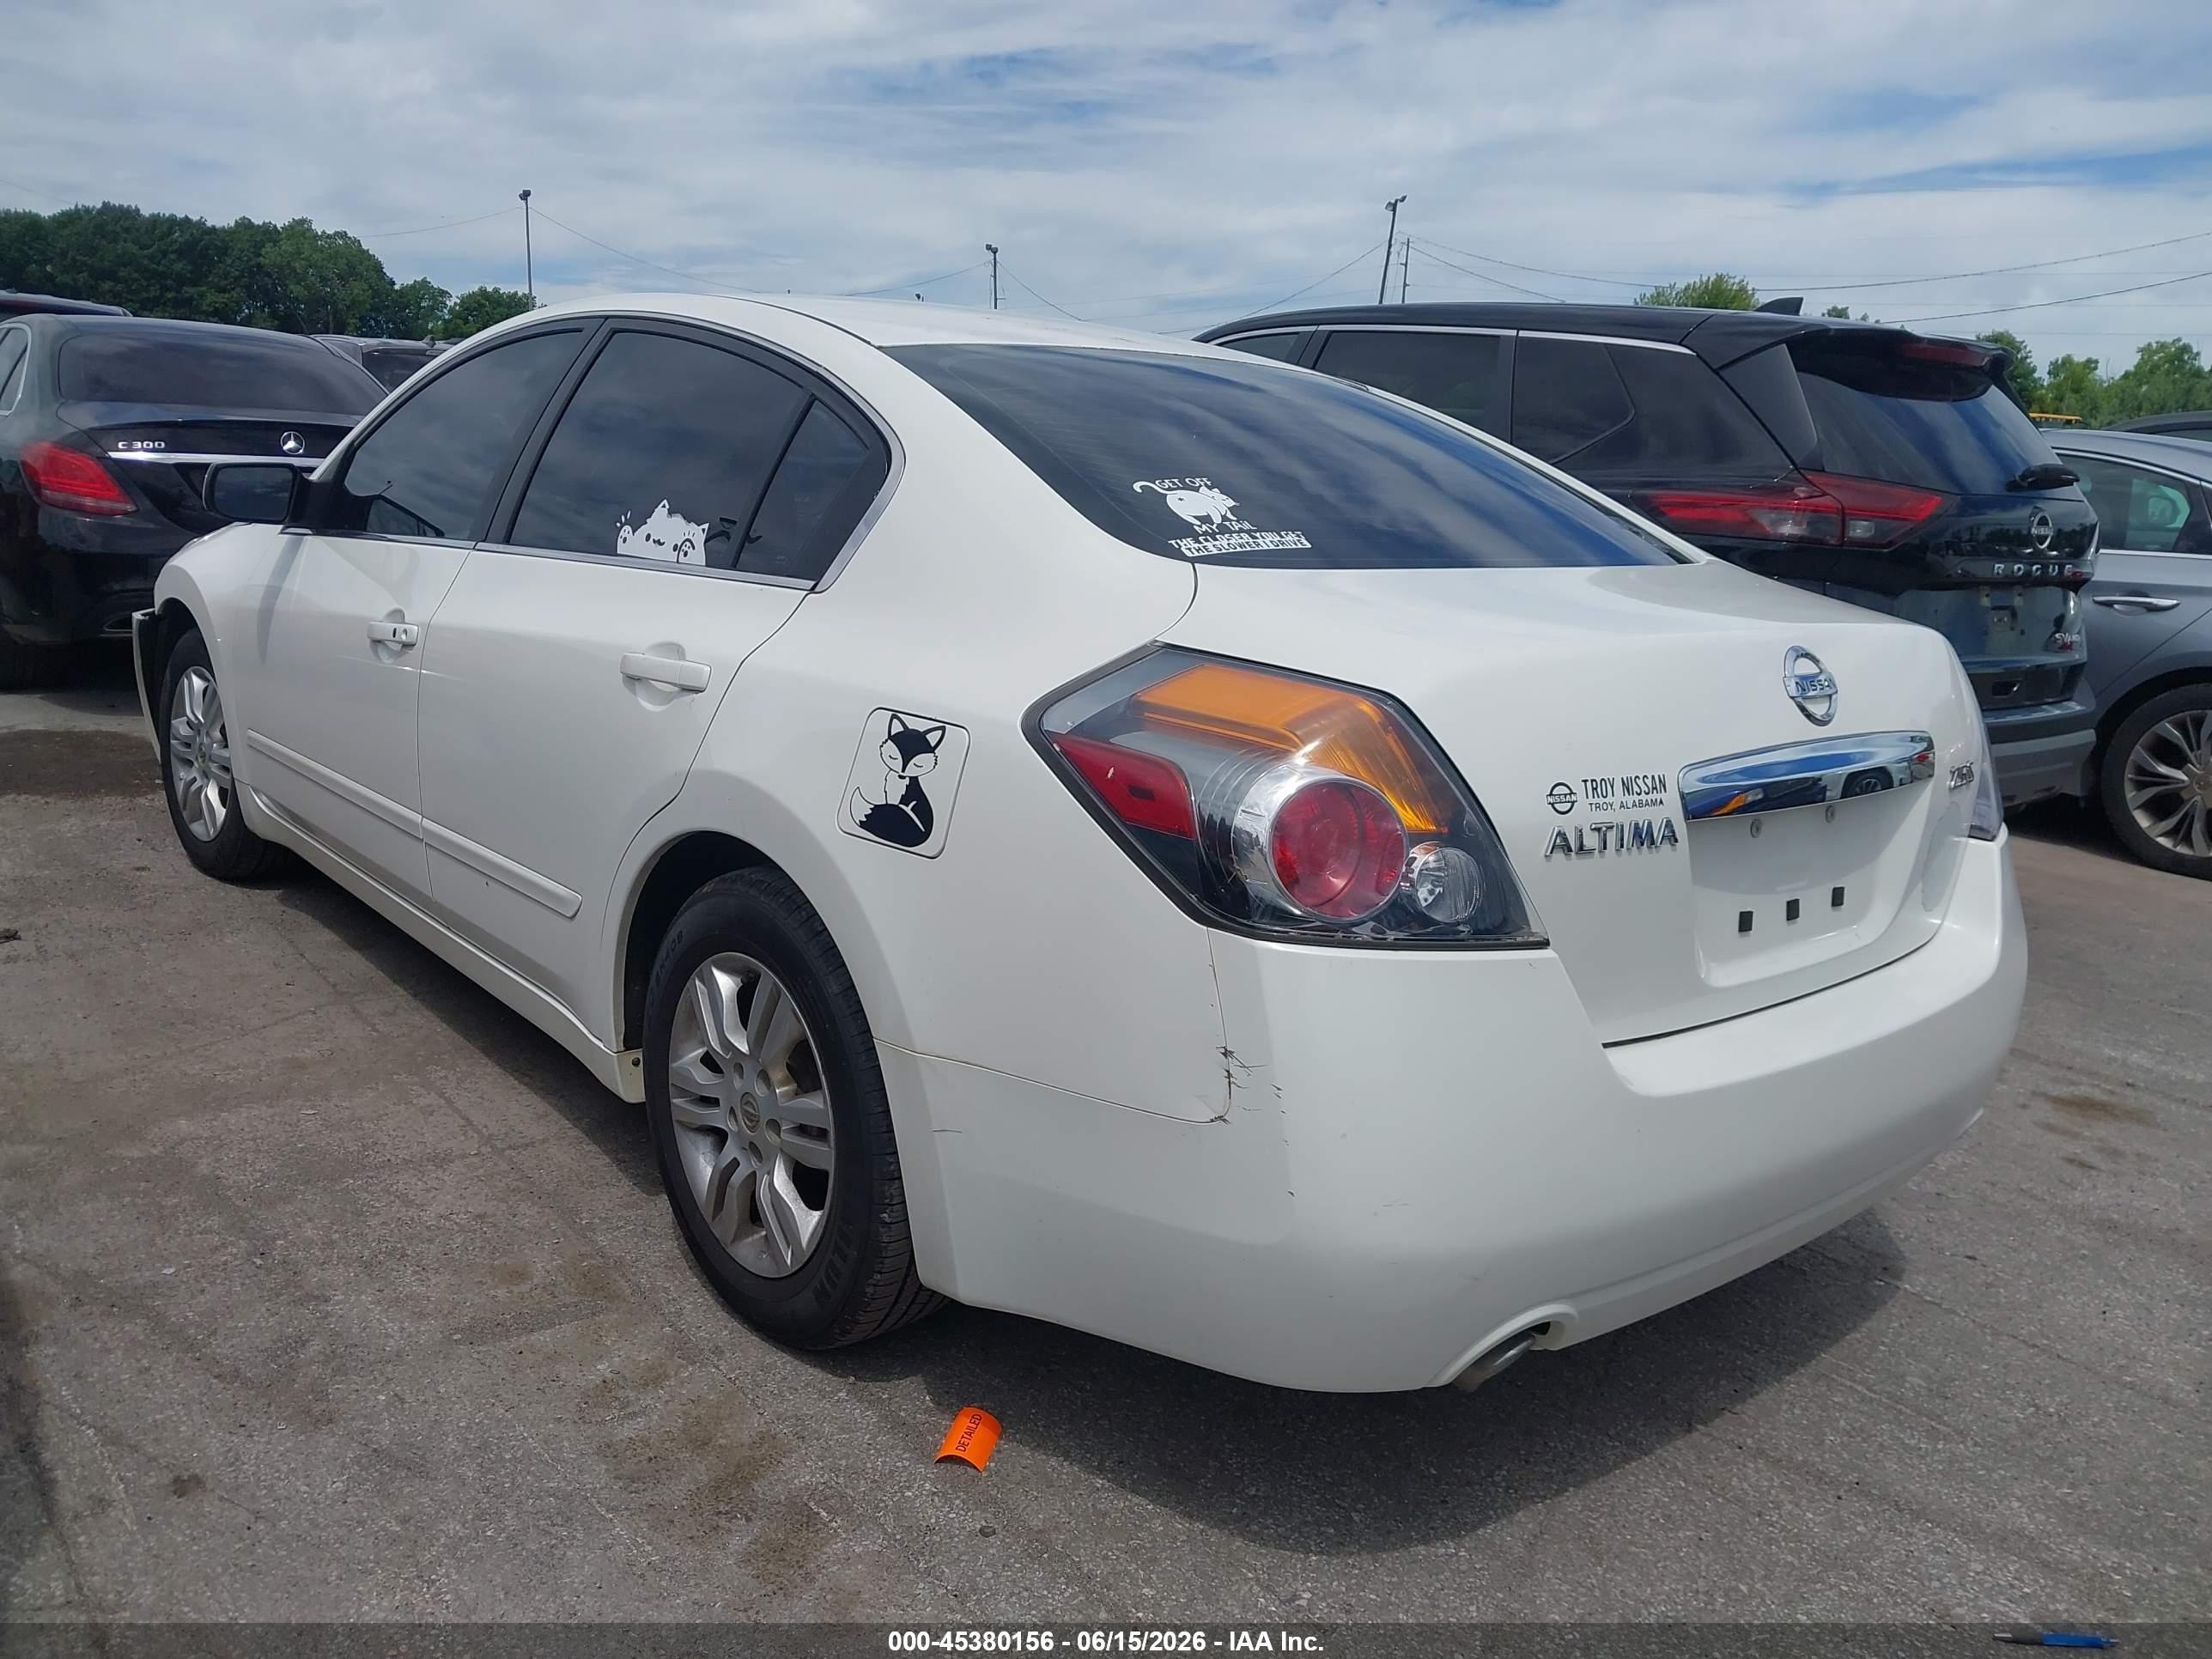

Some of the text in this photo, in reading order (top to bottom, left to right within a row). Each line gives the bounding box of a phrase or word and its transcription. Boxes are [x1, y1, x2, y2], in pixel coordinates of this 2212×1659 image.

[1155, 477, 1212, 489] GET OFF
[1193, 523, 1219, 534] MY
[1168, 538, 1195, 548] THE
[1198, 532, 1251, 545] CLOSER
[1251, 532, 1279, 540] YOU
[1185, 544, 1212, 555] THE
[1212, 540, 1263, 552] SLOWER
[1270, 538, 1307, 548] DRIVE
[1993, 563, 2075, 576] ROGUE
[1581, 774, 1667, 799] TROY NISSAN
[1547, 793, 1577, 804] NISSAN
[1588, 797, 1664, 812] TROY, ALABAMA
[1545, 817, 1679, 857] ALTIMA
[955, 1413, 982, 1453] DETAILED
